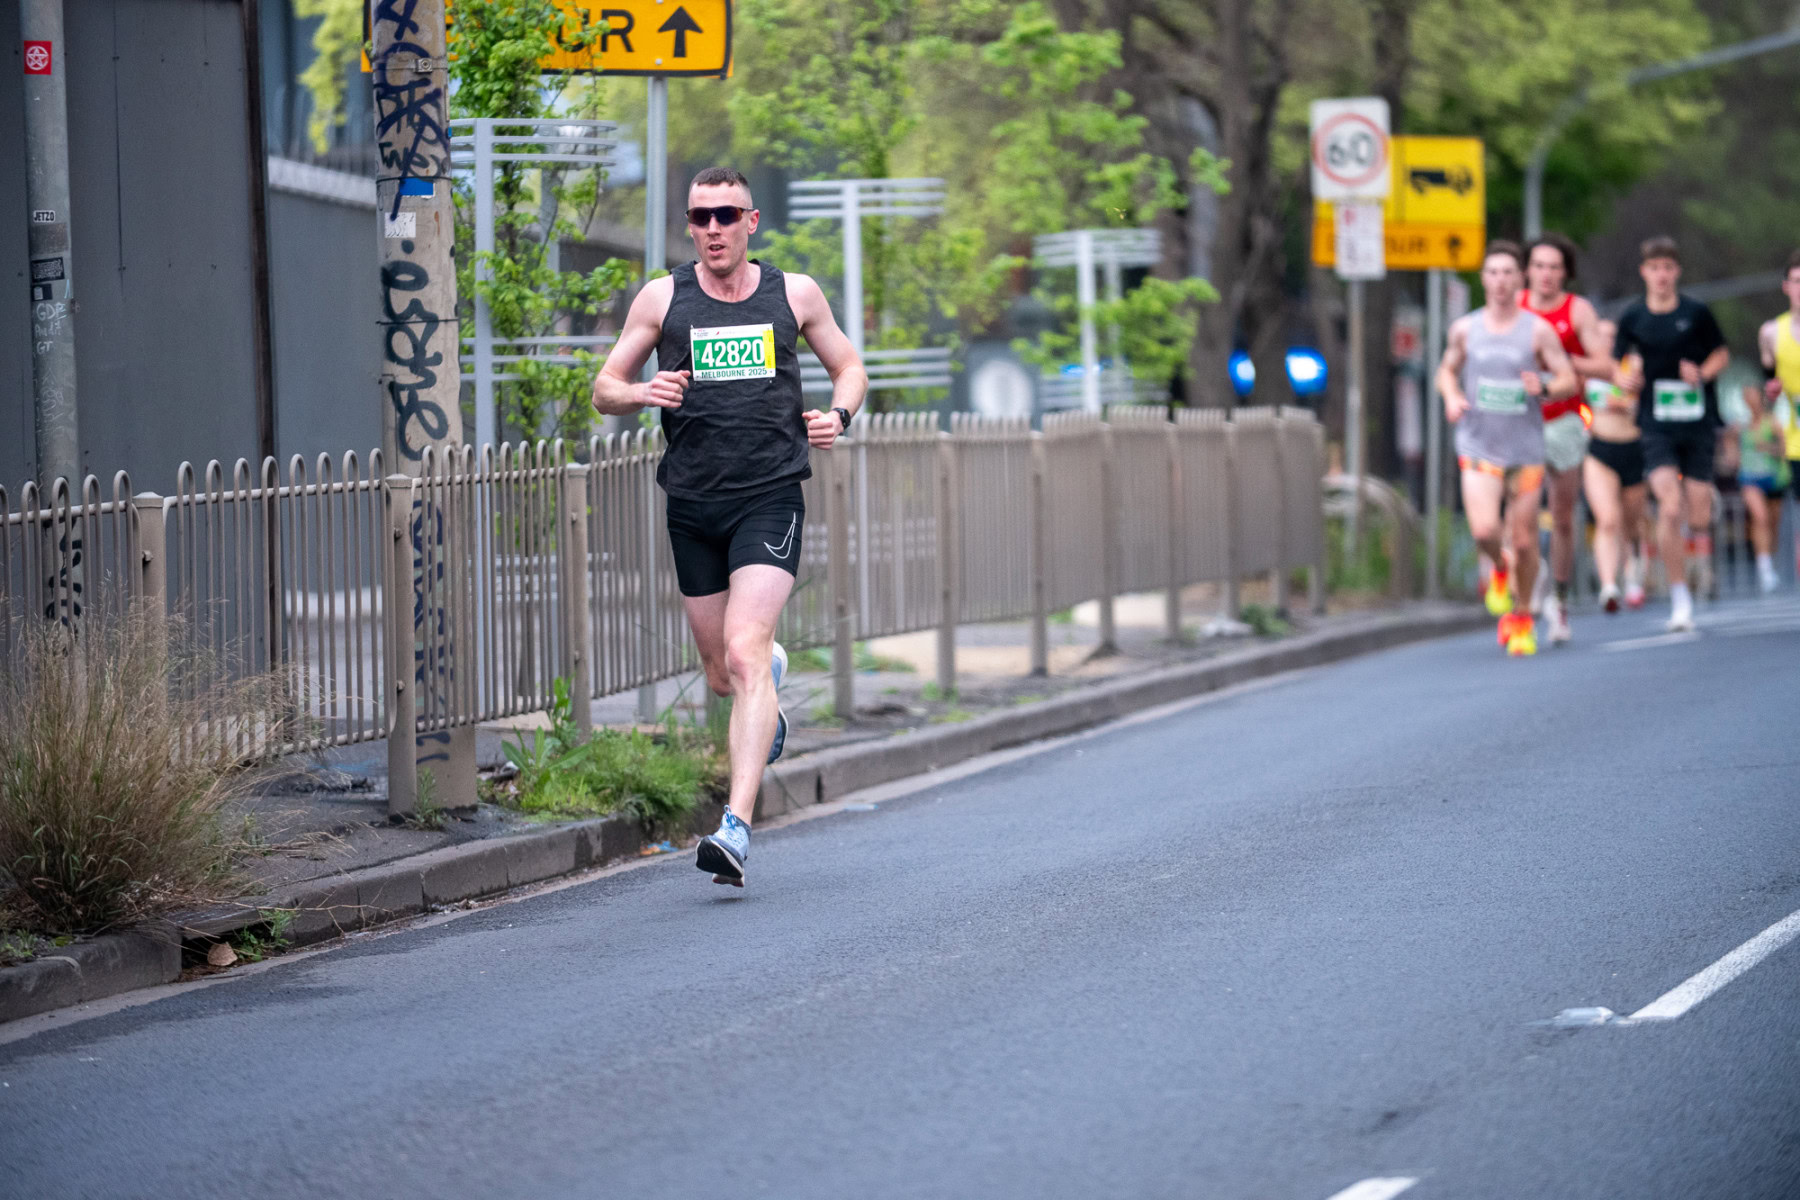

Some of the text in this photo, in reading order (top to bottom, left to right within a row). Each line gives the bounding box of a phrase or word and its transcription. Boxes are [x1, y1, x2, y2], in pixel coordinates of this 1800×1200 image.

[555, 8, 635, 52] UR
[1328, 132, 1374, 167] 60
[701, 338, 766, 368] 42820
[701, 367, 768, 379] MELBOURNE 2025
